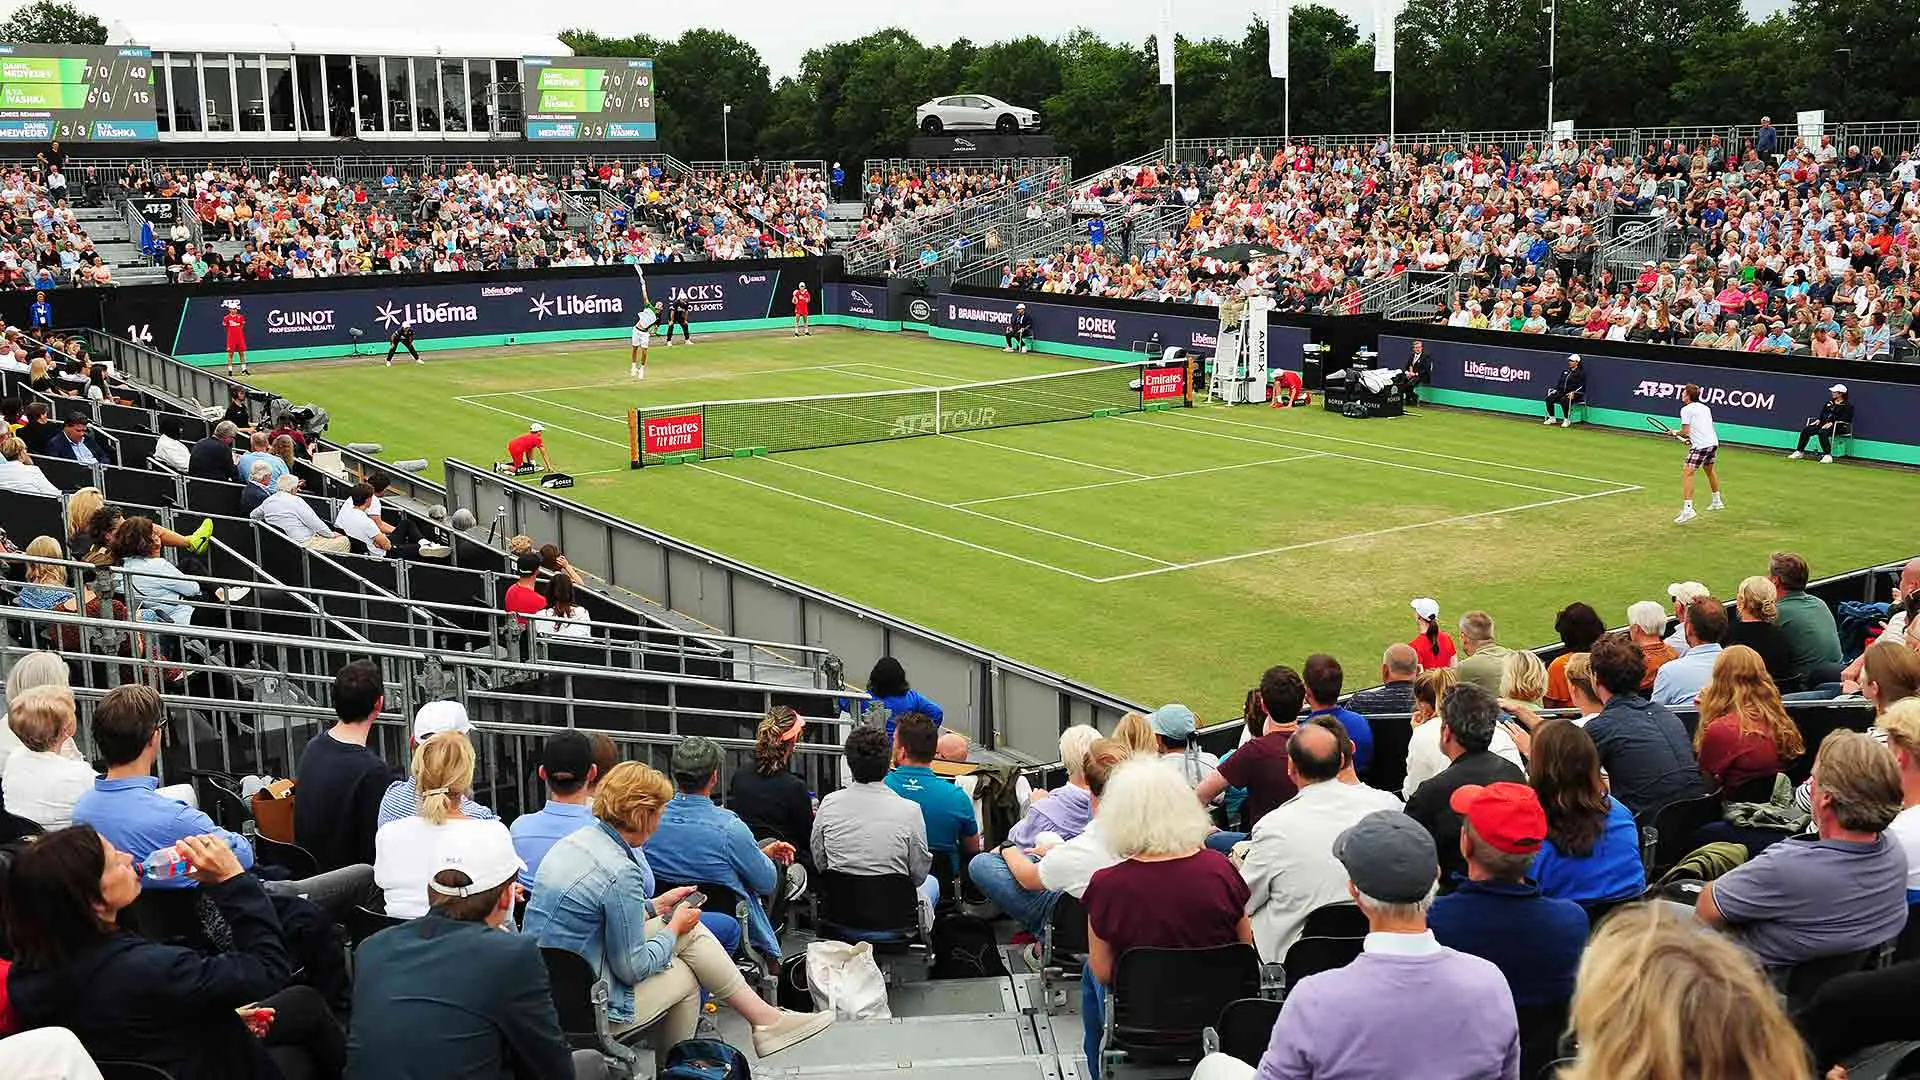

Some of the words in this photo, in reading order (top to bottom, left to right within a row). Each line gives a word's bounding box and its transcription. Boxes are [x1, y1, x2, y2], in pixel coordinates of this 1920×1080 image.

[86, 66, 93, 78] 7
[100, 66, 108, 78] 0
[130, 66, 147, 79] 40
[603, 75, 610, 85] 7
[614, 76, 621, 86] 0
[636, 76, 649, 86] 40
[102, 92, 111, 103] 0
[133, 92, 149, 104] 15
[615, 98, 622, 107] 0
[638, 97, 650, 107] 15
[61, 126, 70, 136] 3
[77, 126, 86, 136] 3
[584, 127, 591, 136] 3
[596, 127, 603, 136] 3
[142, 203, 173, 215] ATP
[159, 211, 173, 219] 250
[669, 285, 723, 301] JACK'S
[556, 294, 623, 315] Libéma
[700, 303, 724, 311] SPORTS
[267, 310, 335, 328] GUINOT
[404, 302, 477, 325] Libéma
[958, 307, 1012, 324] BRABANTSPORT
[313, 324, 335, 332] BEAUTY
[1078, 316, 1116, 334] BOREK
[127, 324, 152, 343] 14
[1191, 332, 1217, 345] Libéma
[1464, 360, 1499, 376] Libéma
[1499, 365, 1531, 382] Open
[1145, 375, 1181, 386] Emirates
[941, 407, 997, 430] TOUR
[649, 422, 698, 437] Emirates
[656, 437, 668, 447] FLY
[669, 433, 692, 446] BETTER
